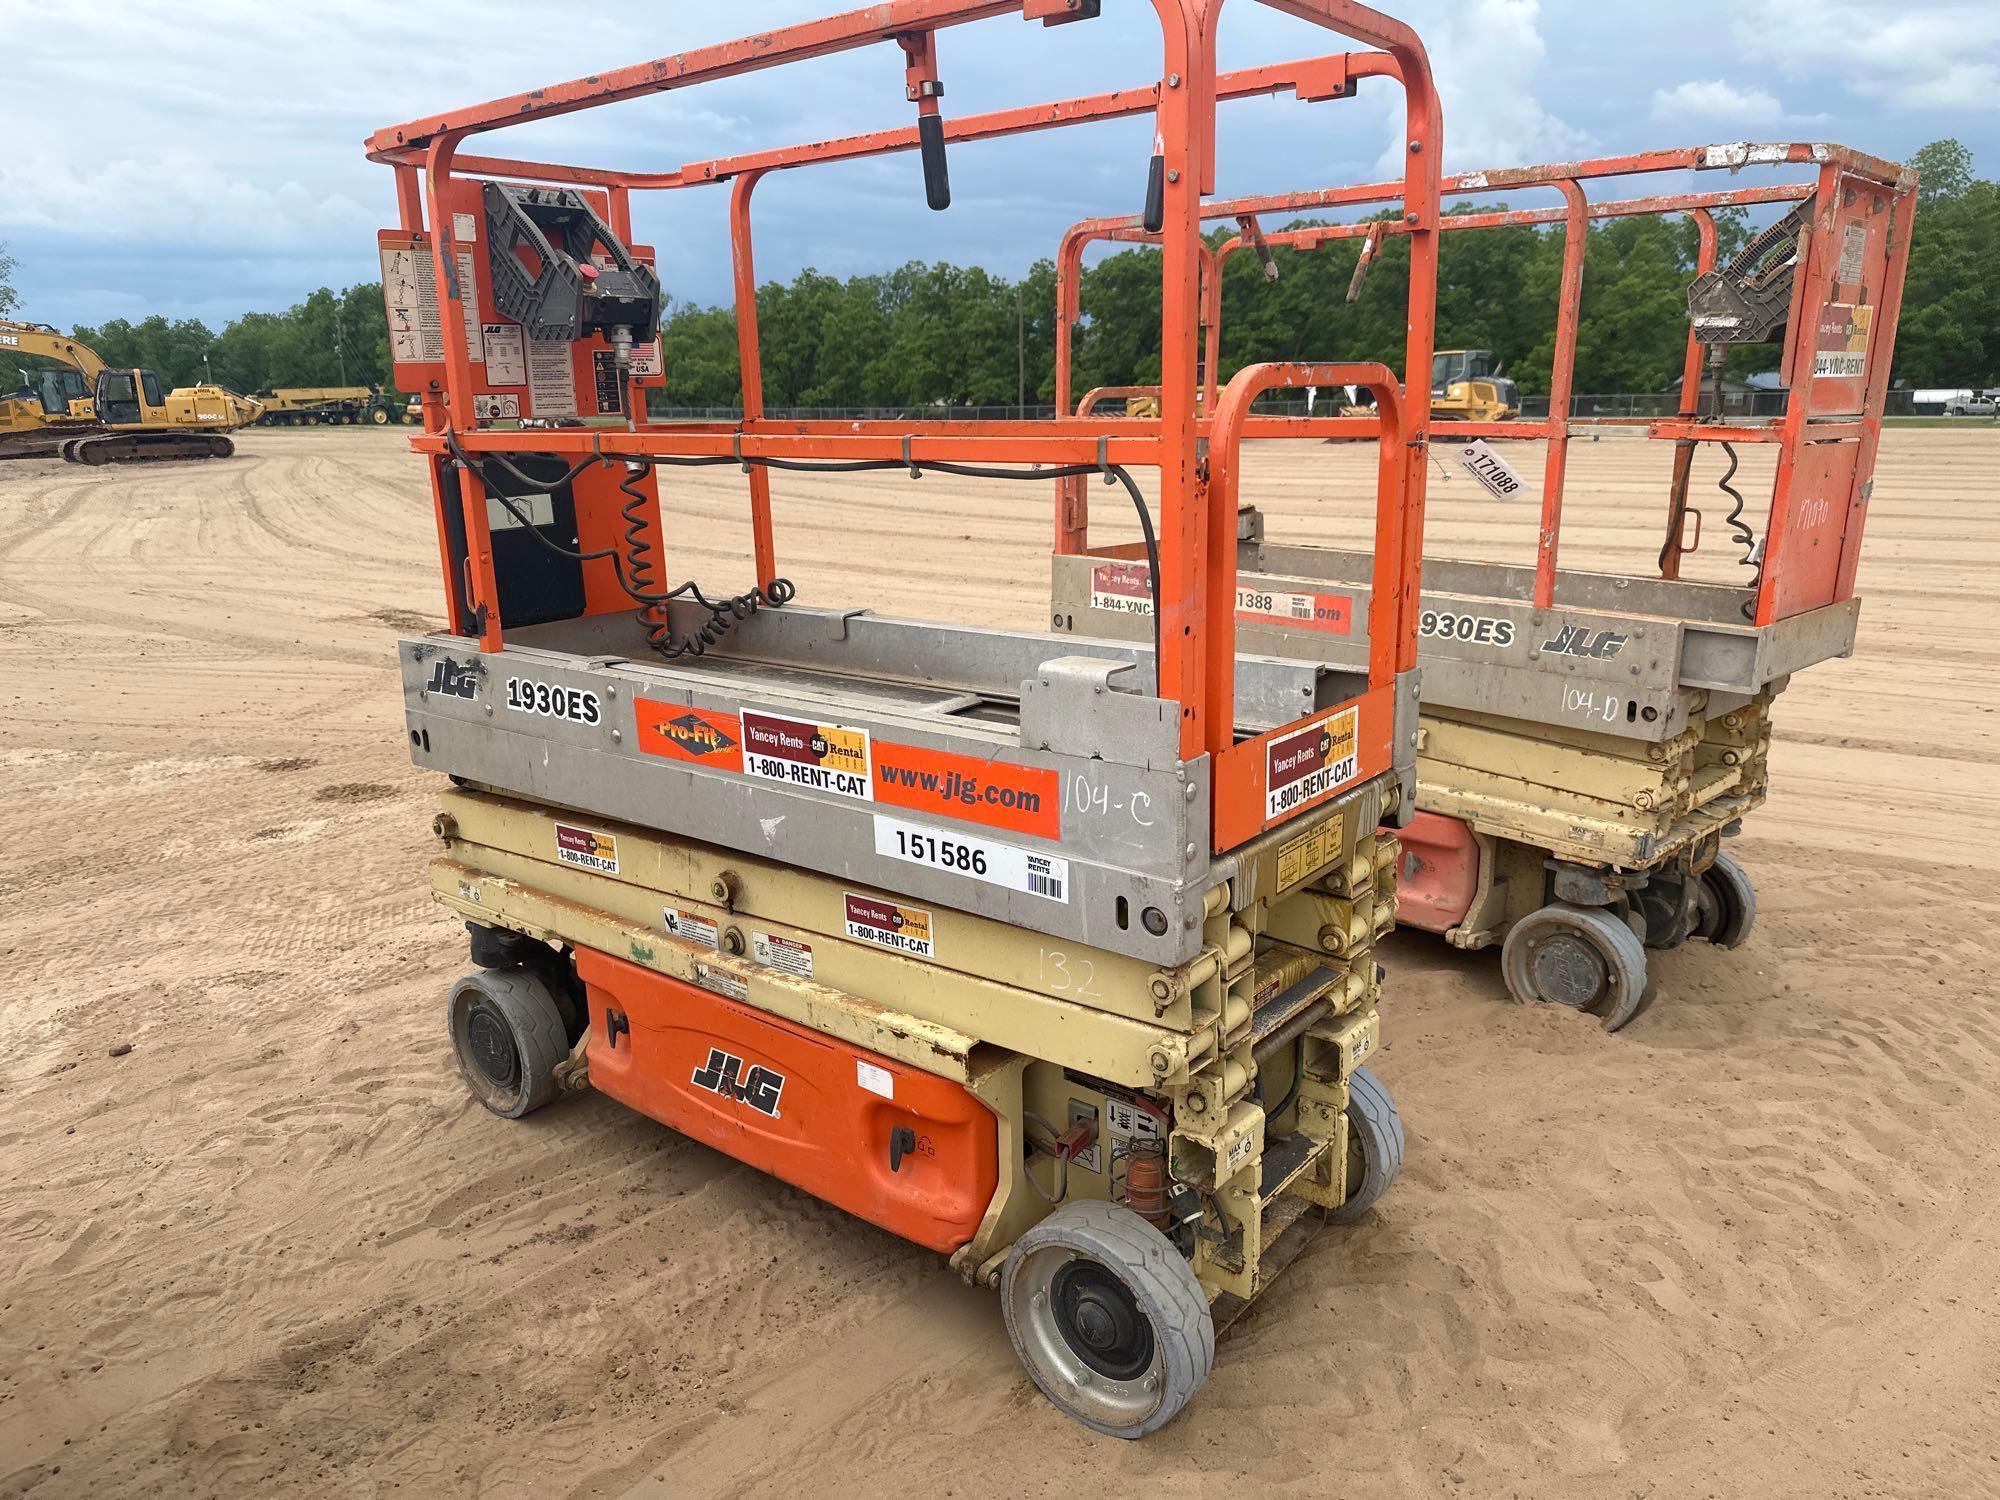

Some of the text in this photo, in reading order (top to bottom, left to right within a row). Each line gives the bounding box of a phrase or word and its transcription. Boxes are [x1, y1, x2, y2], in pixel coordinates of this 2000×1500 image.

[636, 365, 649, 373] USA
[1474, 453, 1518, 493] 171088
[1121, 575, 1140, 586] Rents
[1419, 611, 1515, 648] 930ES
[1539, 624, 1629, 662] JLG
[427, 660, 477, 700] JLG
[507, 677, 600, 726] 1930ES
[1561, 683, 1618, 722] 104-D
[660, 720, 717, 746] Pro-Fit
[750, 726, 803, 750] Yancey Rents
[1320, 727, 1354, 752] CAT Rental
[812, 739, 863, 760] CAT Rental
[1273, 746, 1314, 774] Yancey Rents
[748, 756, 866, 796] 1-800-RENT-CAT
[880, 764, 1040, 814] www.jlg.com
[1271, 758, 1353, 813] 1-800-RENT-CAT
[1062, 769, 1153, 826] 104-C
[560, 832, 574, 845] Yancey
[896, 830, 987, 876] 151586
[560, 849, 617, 872] 1-800-RENT-CAT
[1026, 855, 1051, 868] YANCEY
[1028, 863, 1050, 875] RENTS
[849, 904, 887, 922] Yancey Rents
[905, 918, 927, 931] Rental
[848, 923, 930, 955] 1-800-RENT-CAT
[1039, 947, 1102, 997] 132
[691, 1047, 785, 1118] JLG
